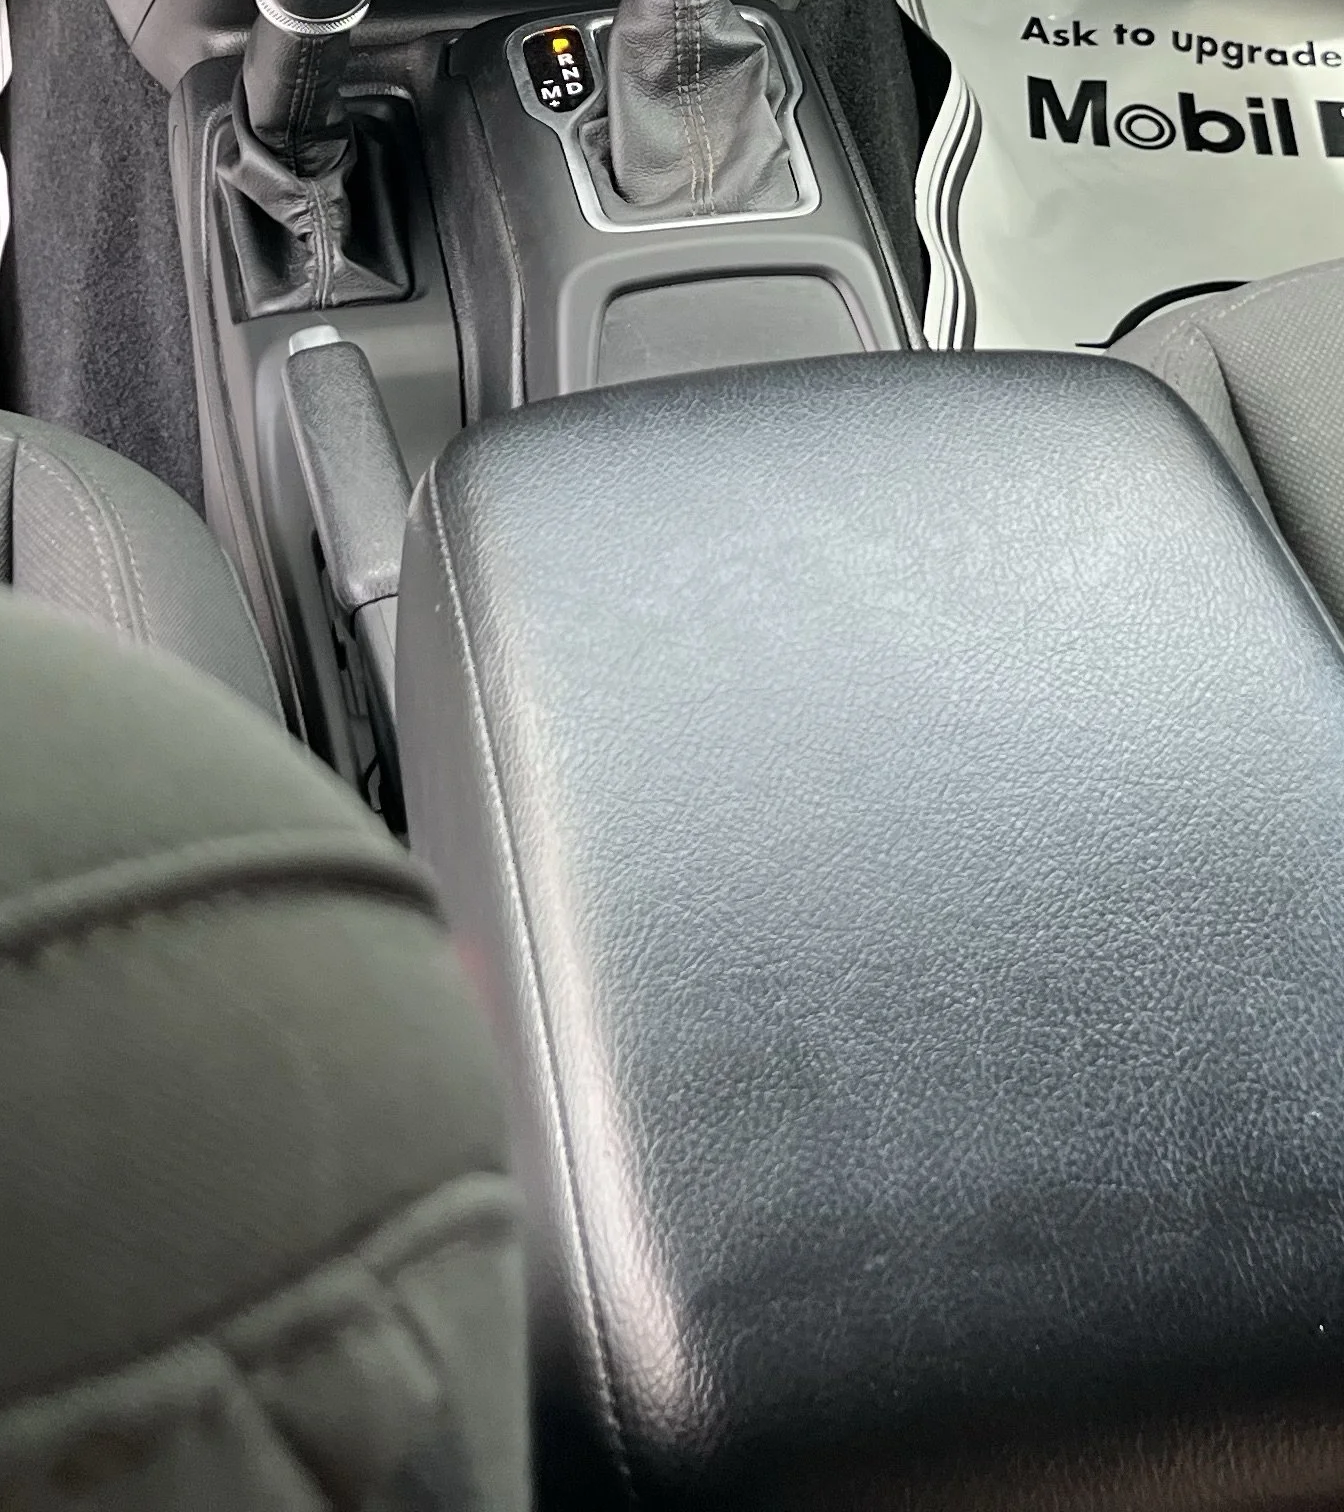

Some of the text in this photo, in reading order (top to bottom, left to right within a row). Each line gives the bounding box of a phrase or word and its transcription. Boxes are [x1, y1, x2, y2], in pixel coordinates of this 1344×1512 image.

[1020, 15, 1099, 48] Ask
[1113, 23, 1156, 47] to
[1171, 29, 1343, 70] upgrade
[557, 53, 575, 66] R
[561, 66, 580, 81] N
[540, 85, 562, 100] M
[565, 81, 584, 95] D
[1027, 75, 1300, 157] Mobil
